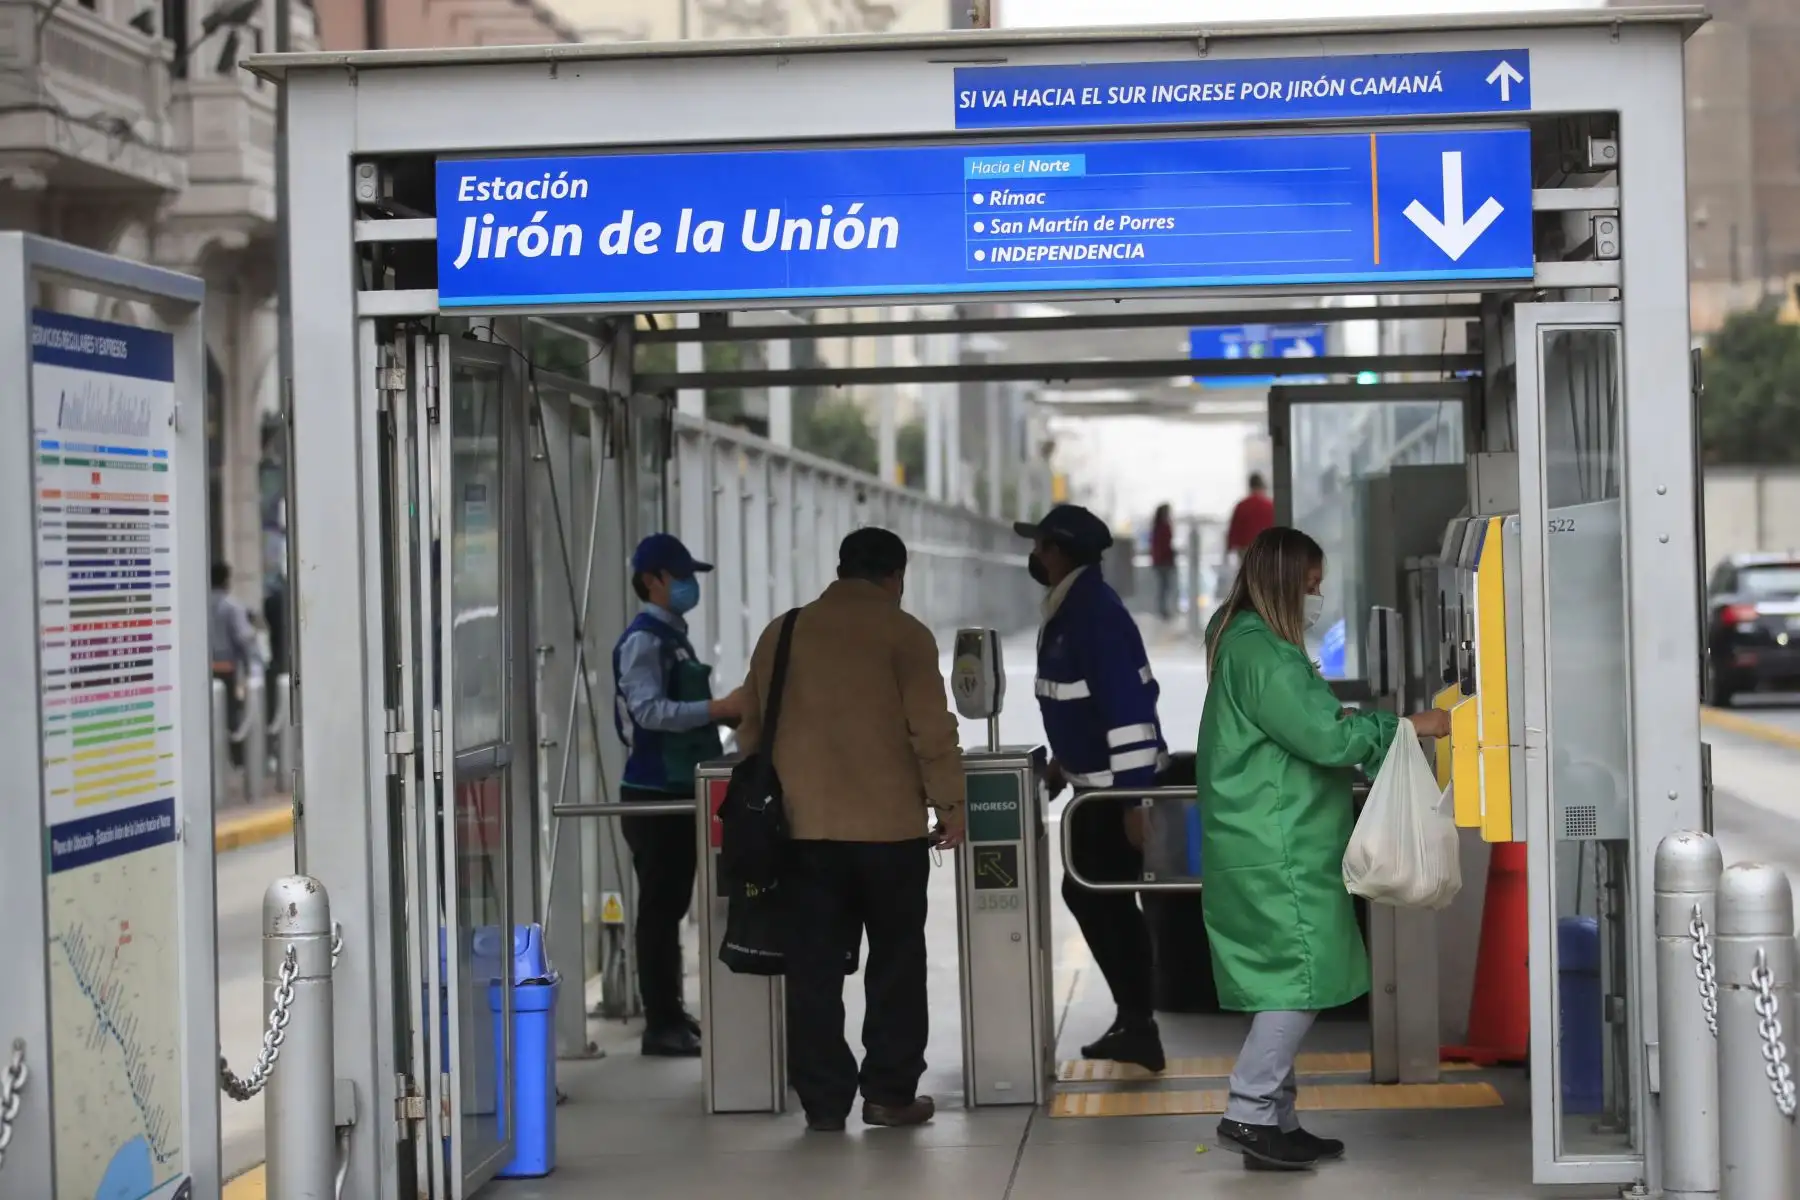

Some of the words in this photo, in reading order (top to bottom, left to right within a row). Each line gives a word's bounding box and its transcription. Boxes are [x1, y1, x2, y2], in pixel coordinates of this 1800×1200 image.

[959, 90, 977, 109] SI
[982, 89, 1008, 108] VA
[1012, 87, 1077, 107] HACIA
[1081, 87, 1103, 105] EL
[1107, 86, 1147, 104] SUR
[1151, 83, 1235, 102] INGRESE
[1240, 81, 1282, 100] POR
[1285, 75, 1346, 101] JIRÓN
[1350, 71, 1443, 95] CAMANÁ
[971, 161, 1010, 174] Hacia
[1013, 160, 1025, 173] el
[1028, 159, 1071, 173] Norte
[457, 171, 589, 202] Estación
[989, 190, 1046, 206] Rímac
[989, 219, 1022, 234] San
[1027, 215, 1089, 234] Martín
[1093, 215, 1116, 231] de
[1119, 215, 1176, 231] Porres
[453, 210, 584, 270] Jirón
[598, 209, 662, 255] de
[675, 208, 724, 253] la
[740, 202, 900, 252] Unión
[991, 243, 1145, 262] INDEPENDENCIA
[1548, 519, 1575, 533] 522
[970, 801, 1018, 812] INGRESO
